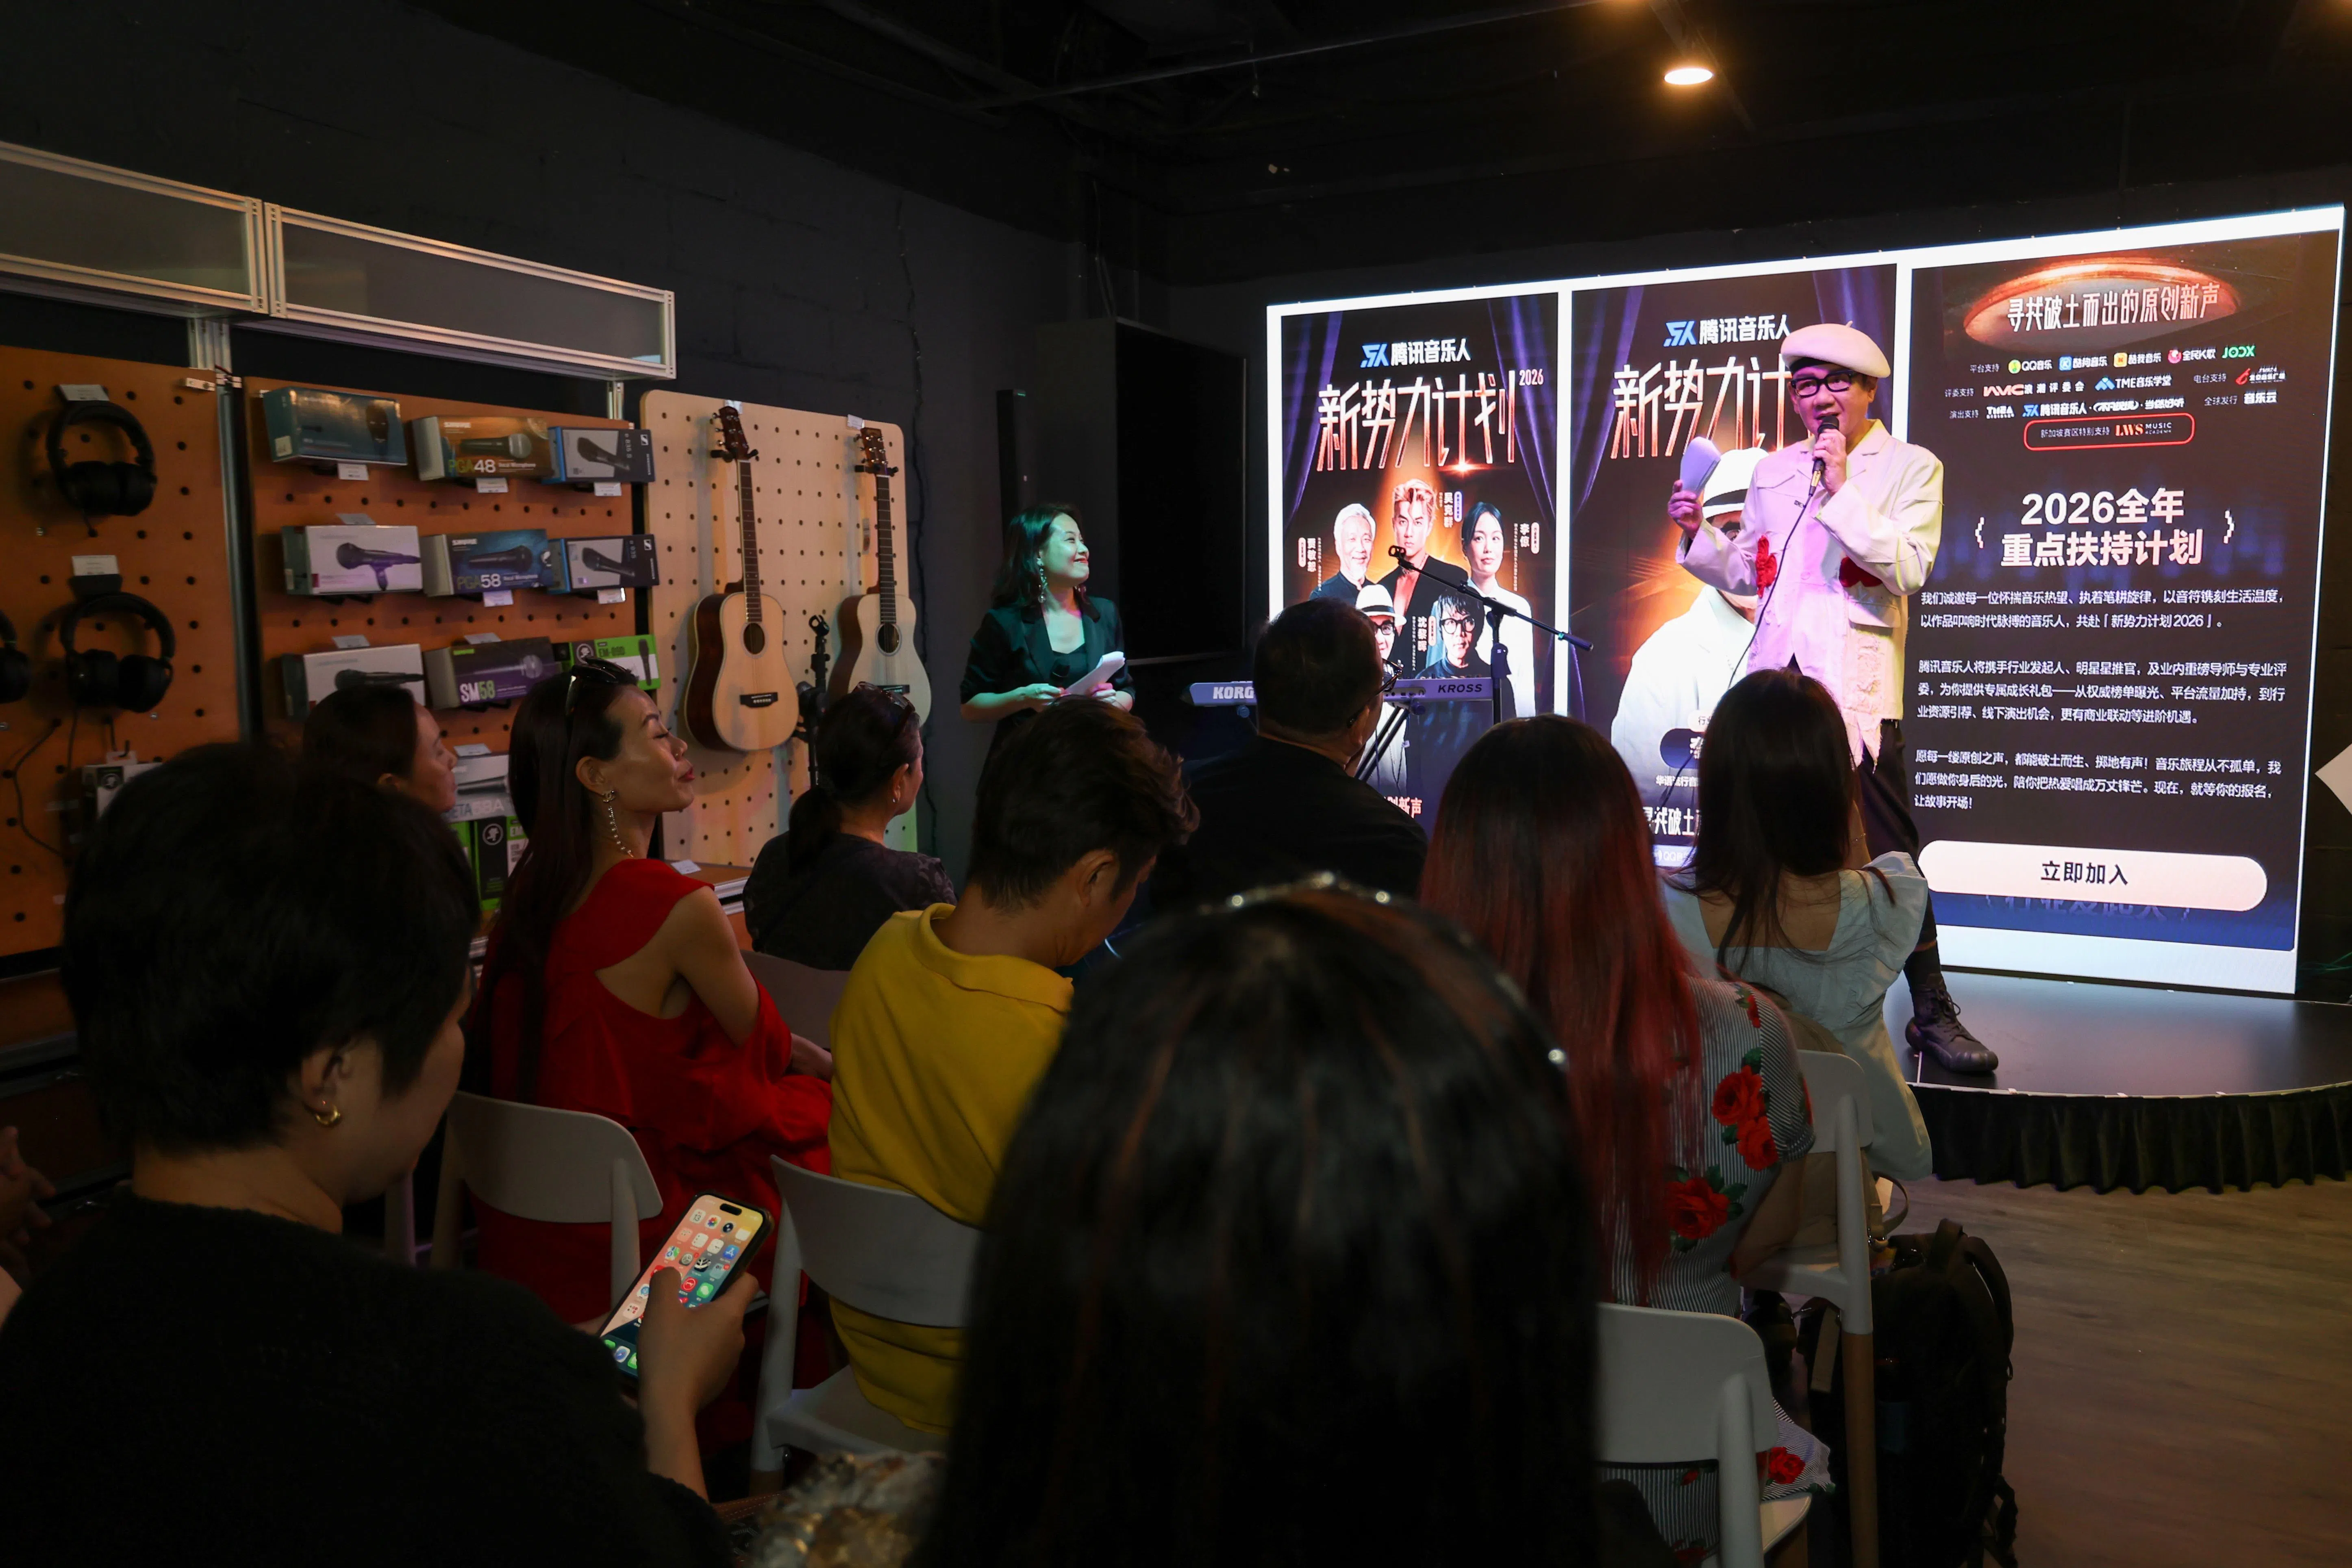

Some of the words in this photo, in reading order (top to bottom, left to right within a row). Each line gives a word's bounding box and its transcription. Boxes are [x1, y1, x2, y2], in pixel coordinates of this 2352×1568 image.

[2007, 282, 2221, 332] 寻找破土而出的原创新声
[1698, 314, 1791, 345] 腾讯音乐人
[1391, 339, 1471, 366] 腾讯音乐人
[1970, 363, 2000, 373] 平台支持
[2022, 359, 2053, 372] QQ音乐
[2073, 356, 2107, 368] 酷狗音乐
[2128, 352, 2162, 364] 酷我音乐
[2182, 348, 2216, 361] 全民K歌
[2222, 345, 2255, 359] JOOX
[1519, 369, 1544, 386] 2026
[1945, 388, 1974, 397] 评委支持
[2115, 375, 2172, 388] TME音乐学堂
[2193, 373, 2226, 384] 电台支持
[1611, 353, 1812, 459] 新势力计
[2204, 395, 2237, 406] 全球发行
[2244, 391, 2277, 404] 音乐云
[1316, 370, 1515, 471] 新势力计划
[1950, 409, 1979, 419] 演出支持
[2040, 402, 2087, 416] 腾讯音乐人
[2041, 426, 2110, 438] 新加坡赛区特别支持
[2115, 423, 2143, 436] LWS
[448, 459, 496, 473] PGA48
[2020, 488, 2185, 526] 2026全年
[2000, 529, 2203, 568] 重点扶持计划
[459, 680, 496, 702] SM58
[1213, 686, 1254, 699] KORG
[1438, 684, 1482, 693] KROSS
[1656, 775, 1699, 787] 华语流行音
[2041, 861, 2128, 885] 立即加入
